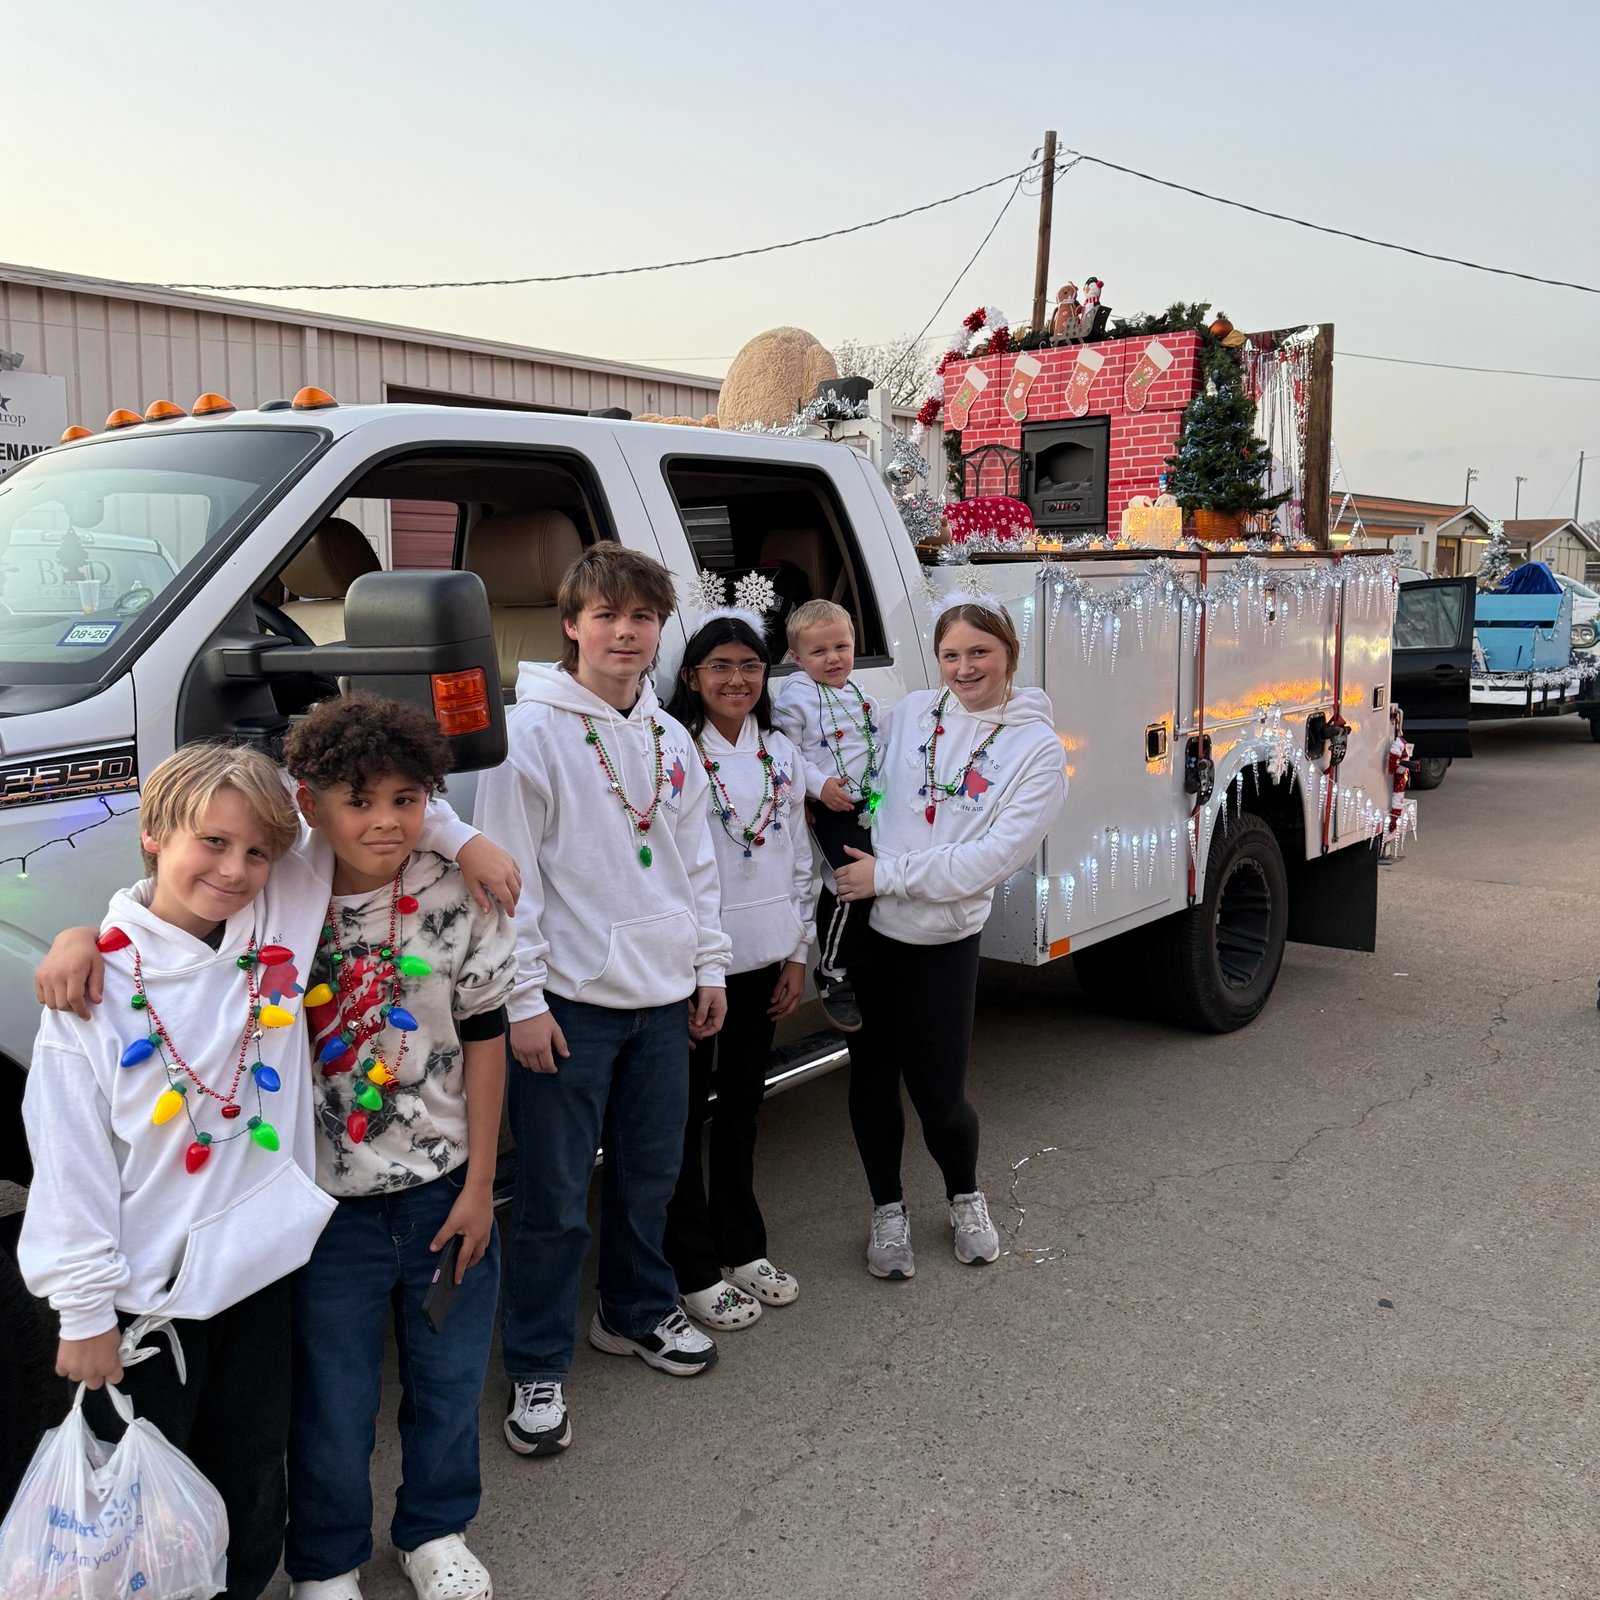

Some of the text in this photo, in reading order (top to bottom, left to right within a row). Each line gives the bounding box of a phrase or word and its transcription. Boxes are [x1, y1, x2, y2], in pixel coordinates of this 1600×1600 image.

[0, 442, 53, 461] ENAN
[664, 746, 686, 755] TEXA
[663, 801, 680, 814] MODE
[94, 1543, 123, 1569] your
